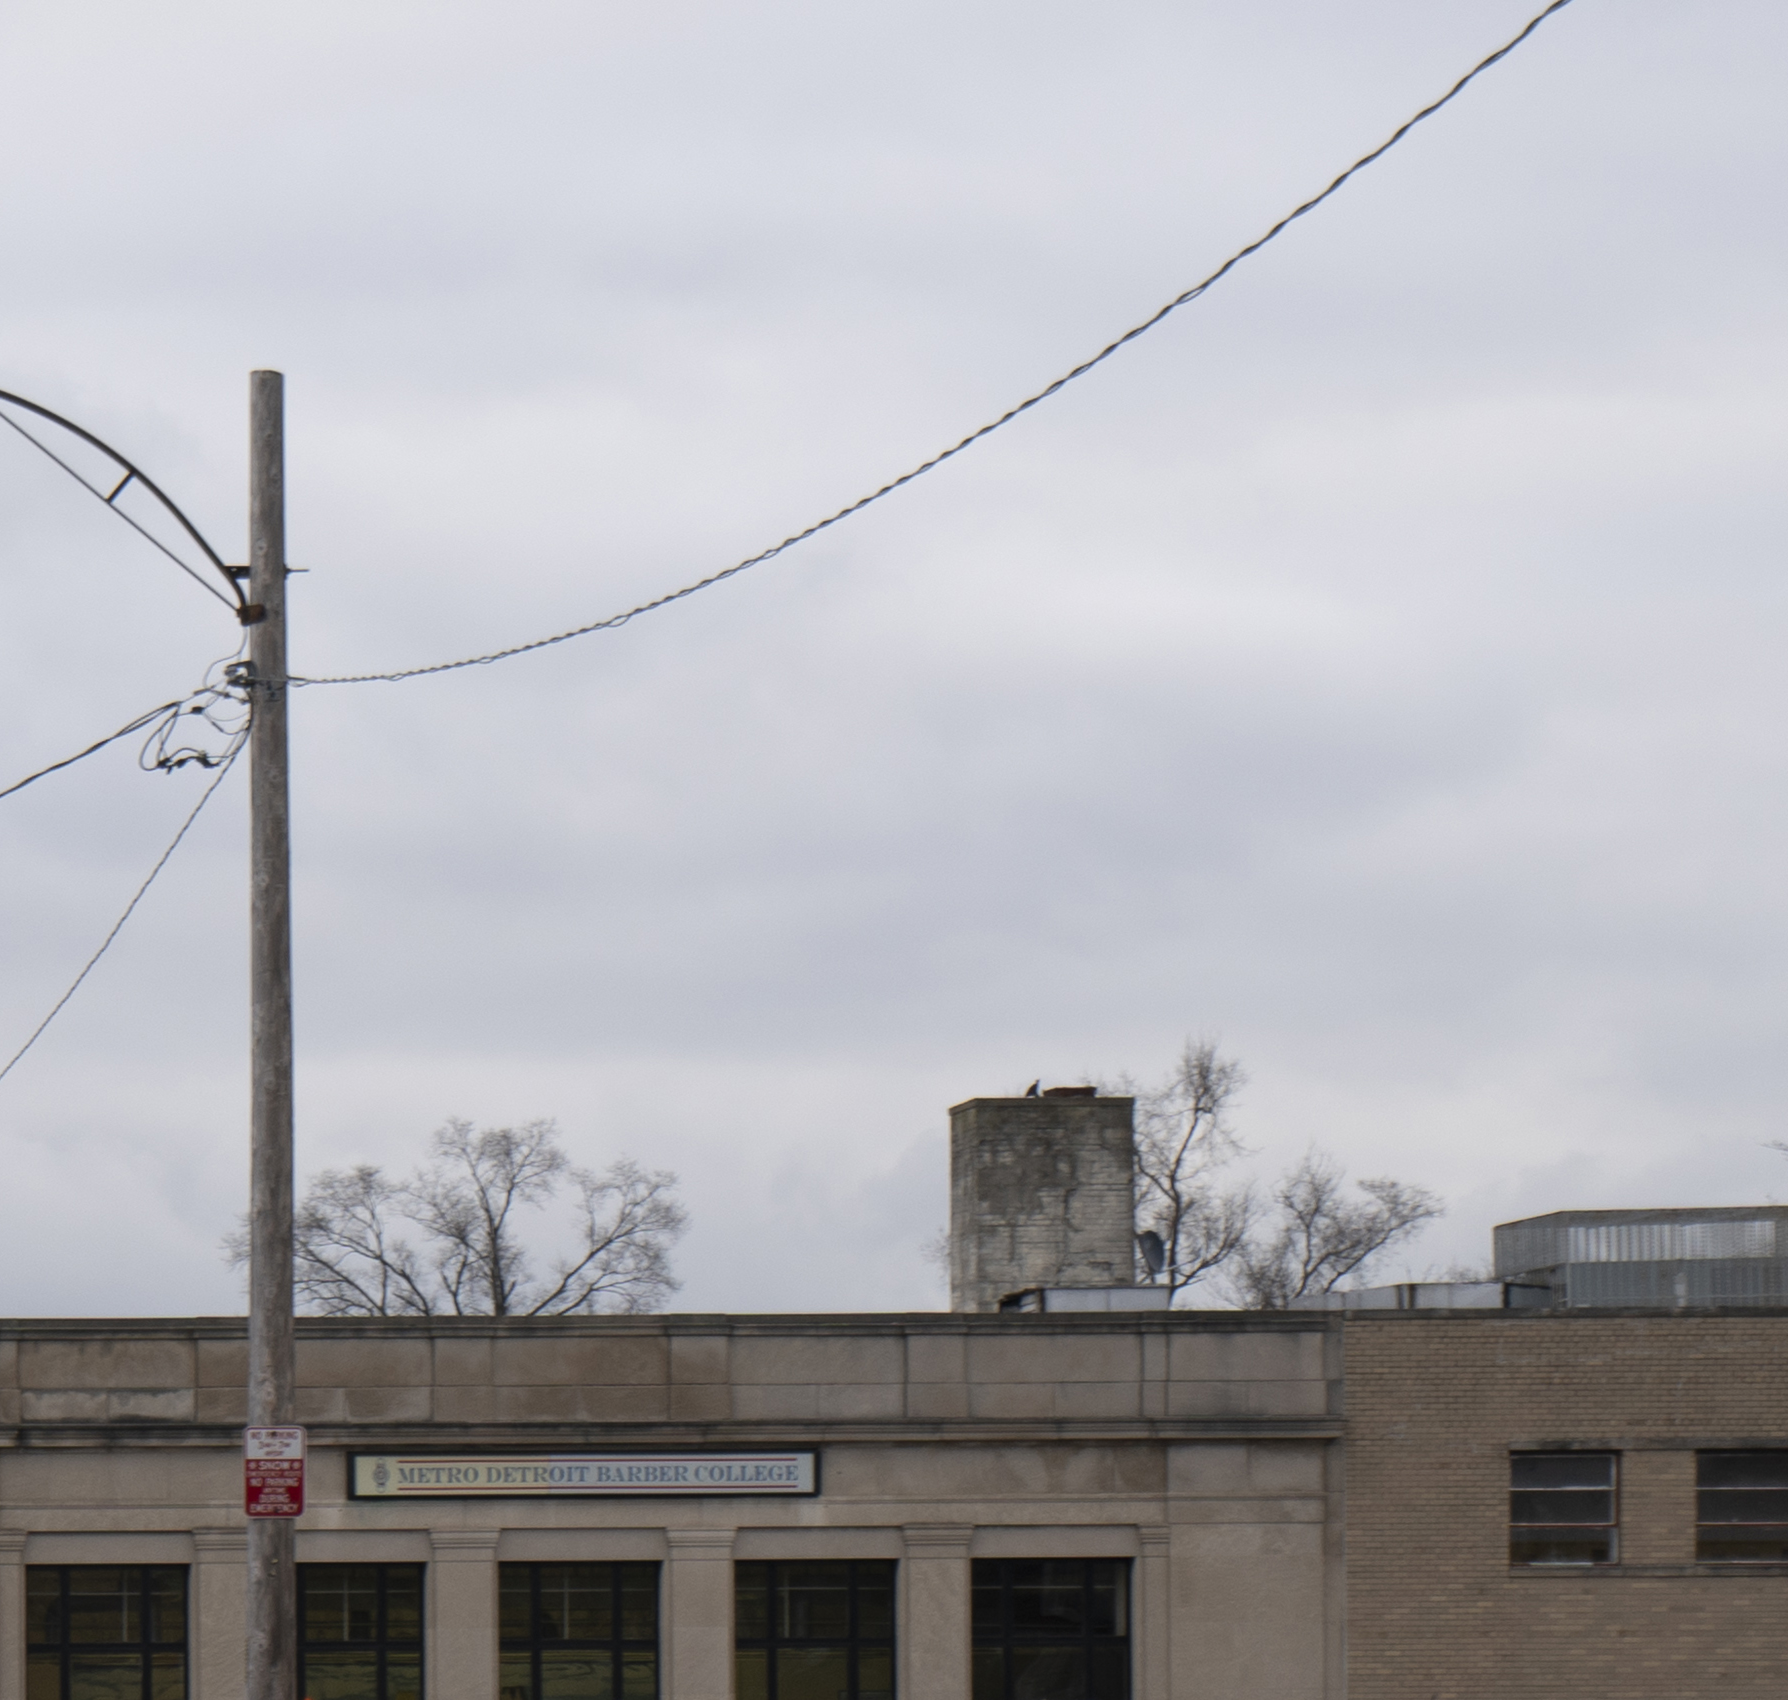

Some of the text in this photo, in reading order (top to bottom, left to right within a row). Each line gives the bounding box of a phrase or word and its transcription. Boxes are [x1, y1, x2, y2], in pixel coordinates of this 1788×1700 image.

[398, 1465, 799, 1484] METRO DETROIT BARBER COLLEGE
